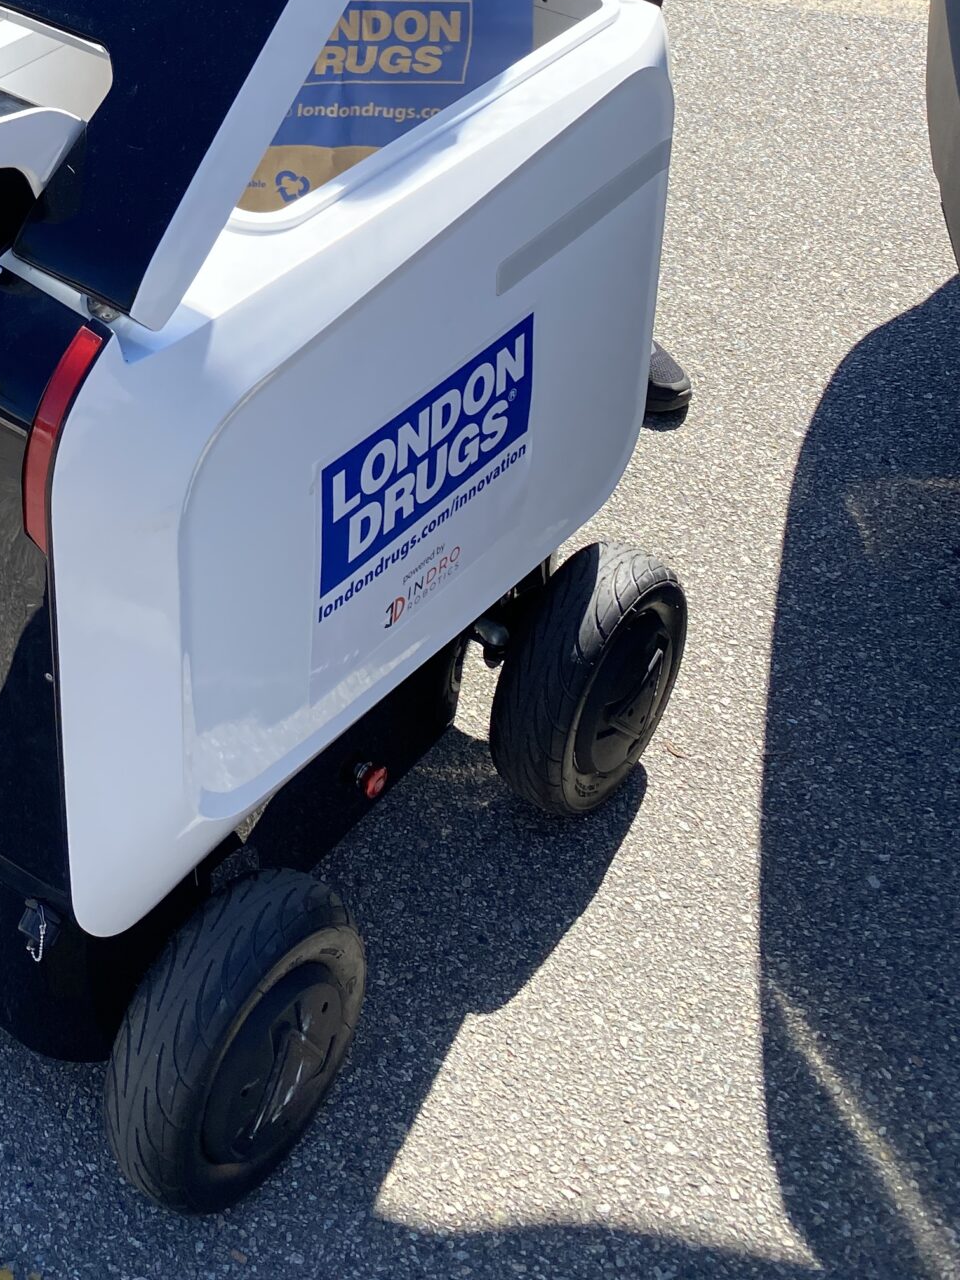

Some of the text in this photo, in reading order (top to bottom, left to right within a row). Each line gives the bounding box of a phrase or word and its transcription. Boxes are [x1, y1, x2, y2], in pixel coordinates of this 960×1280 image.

[329, 9, 461, 43] NDON
[314, 45, 443, 75] RUGS
[297, 102, 441, 123] londondrugs.co
[332, 333, 525, 524] LONDON
[318, 443, 526, 623] londondrugs.com/innovation
[402, 542, 446, 586] powered by
[407, 546, 461, 600] INDRO
[407, 561, 460, 611] ROBOTICS
